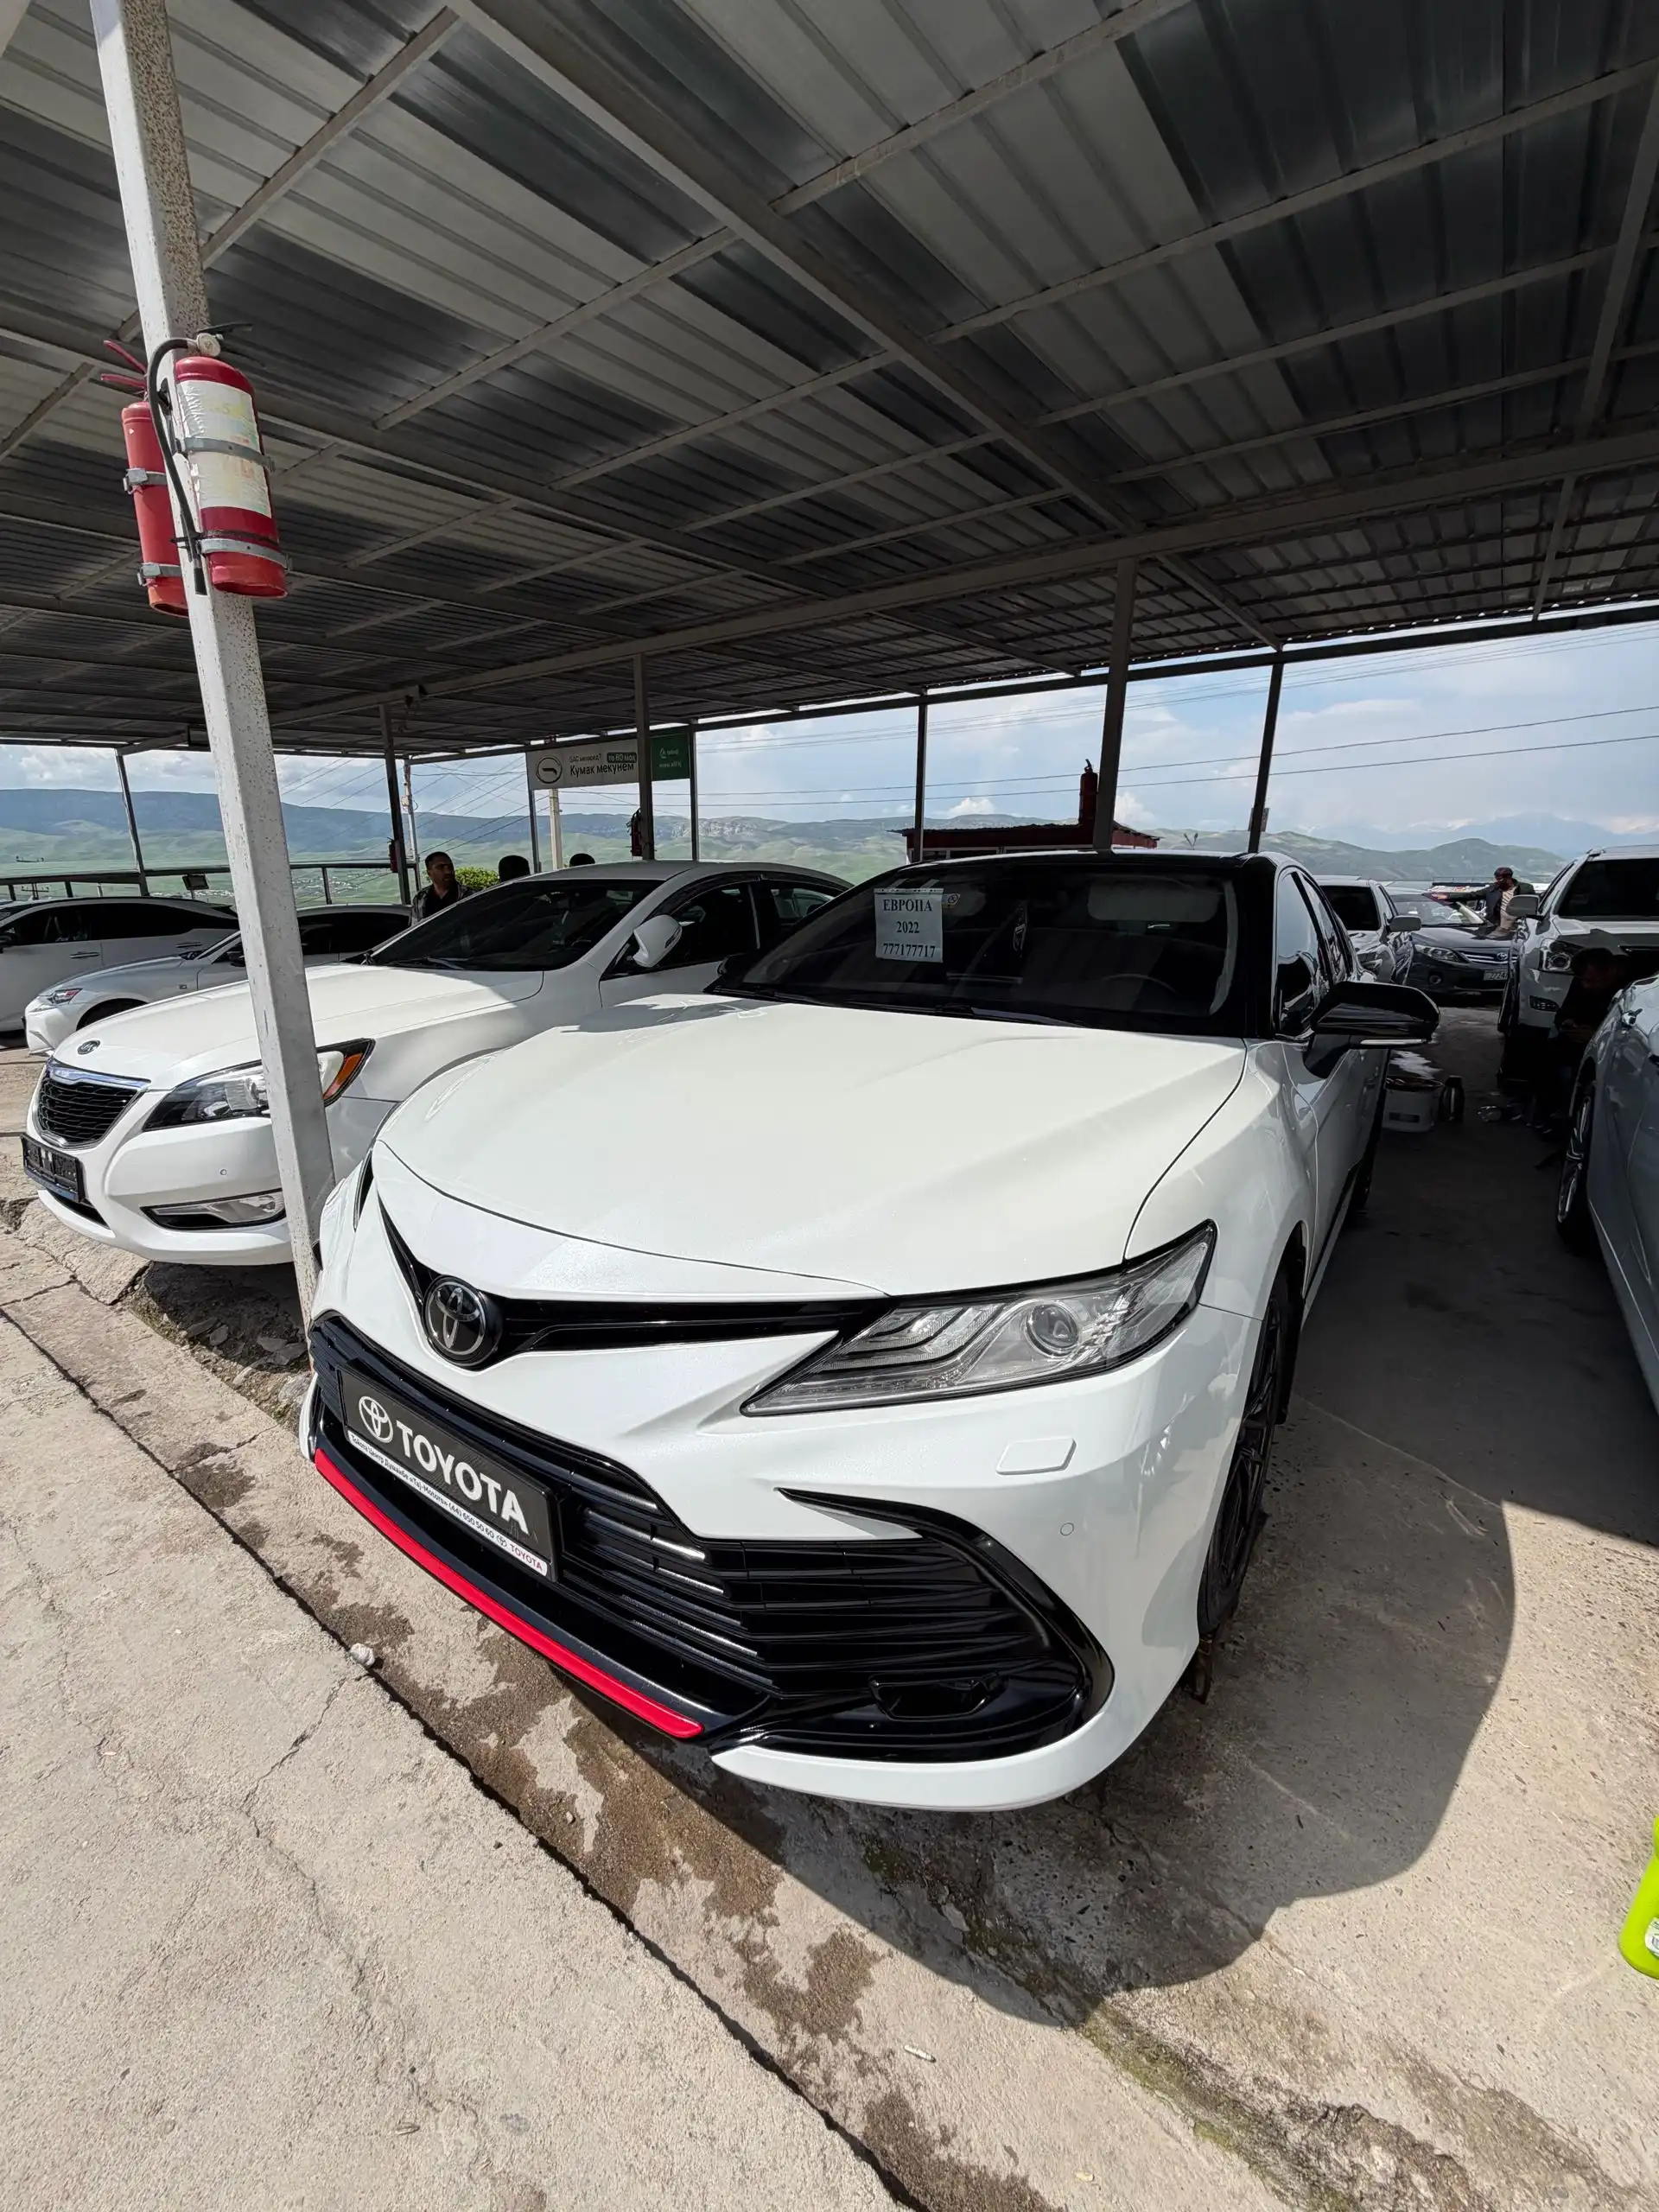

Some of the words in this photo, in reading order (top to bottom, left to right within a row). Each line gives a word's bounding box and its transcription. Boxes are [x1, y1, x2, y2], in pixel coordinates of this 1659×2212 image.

[570, 765, 595, 778] Кумак
[596, 763, 634, 775] мекунем
[883, 899, 932, 912] ЕВРОПА
[896, 920, 920, 933] 2022
[883, 943, 936, 957] 777177717
[397, 1420, 530, 1536] TOYOTA
[463, 1512, 475, 1526] 650
[476, 1522, 485, 1532] 50
[510, 1543, 543, 1572] TOYOTA
